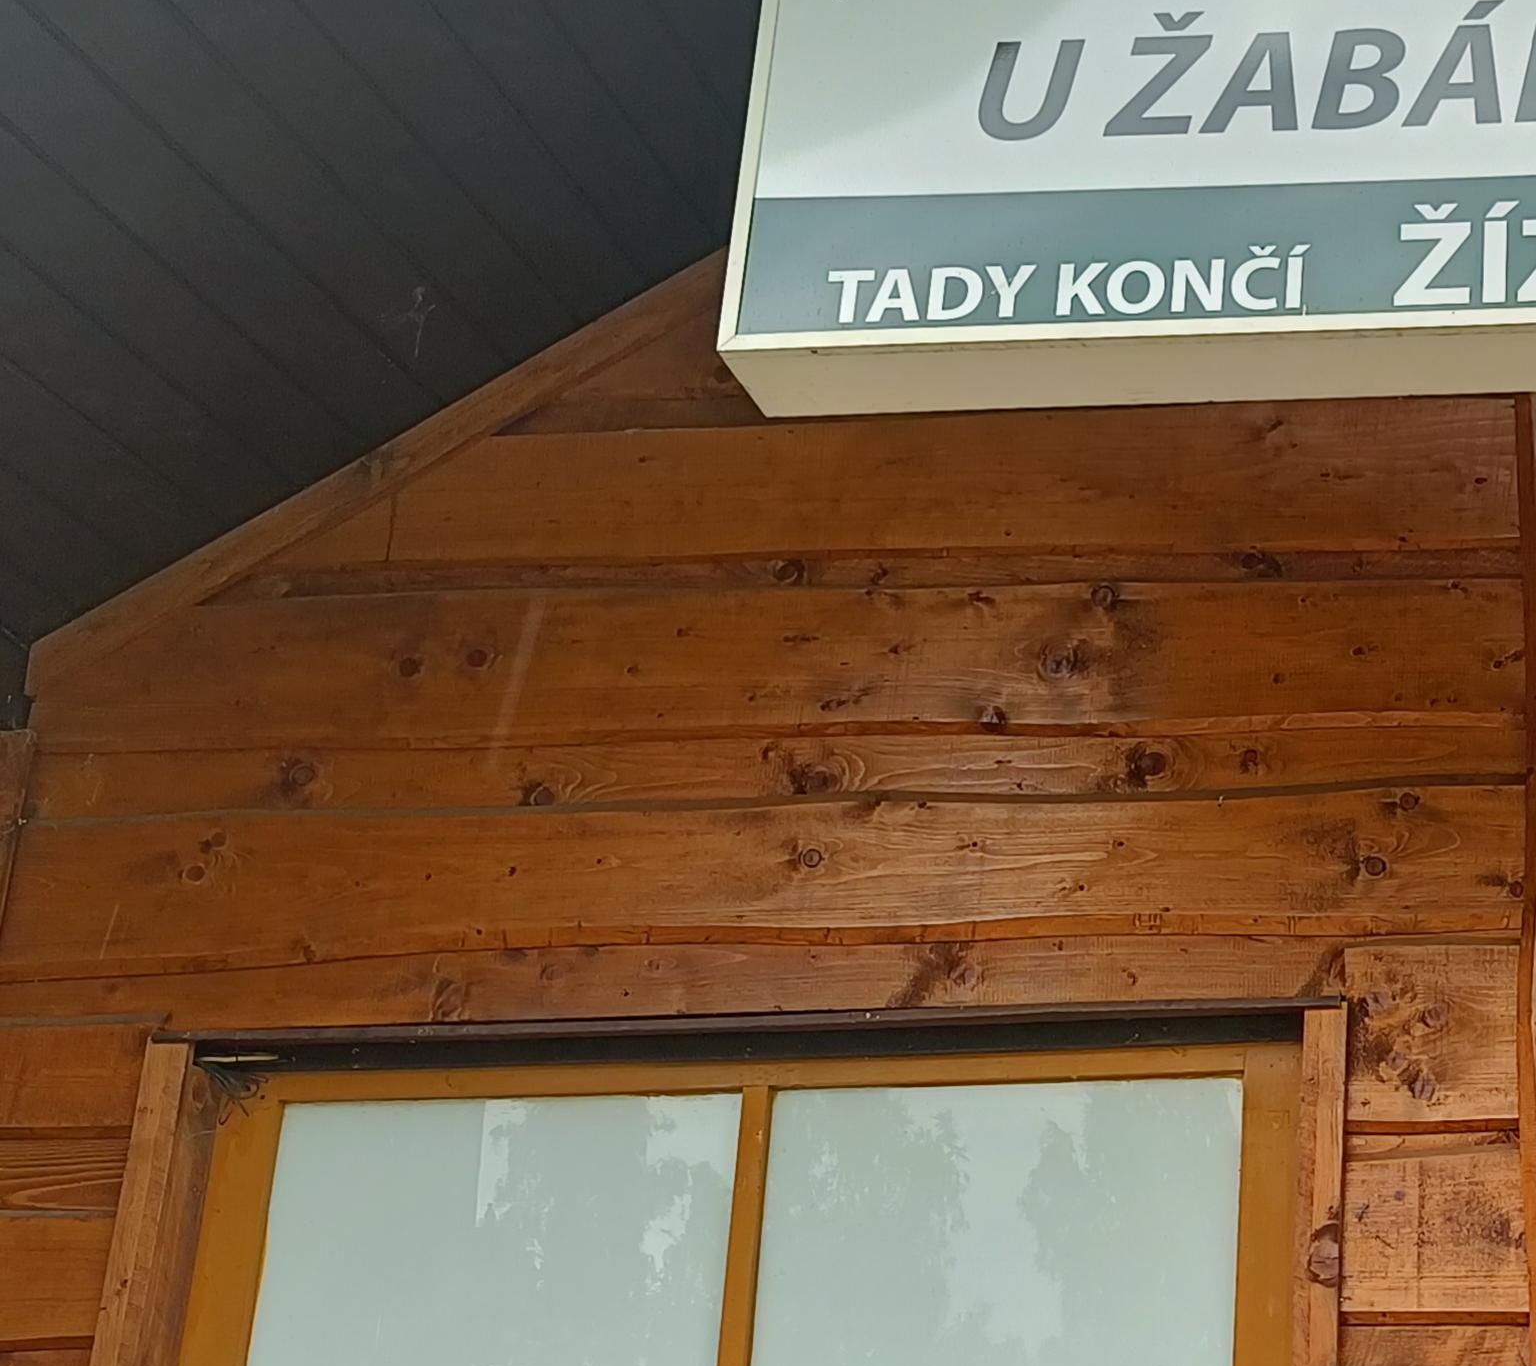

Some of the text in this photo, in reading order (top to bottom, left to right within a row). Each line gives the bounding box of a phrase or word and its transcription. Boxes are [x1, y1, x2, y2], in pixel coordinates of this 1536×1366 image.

[978, 37, 1086, 142] U
[827, 263, 1037, 324] TADY
[1054, 243, 1312, 317] KONČÍ
